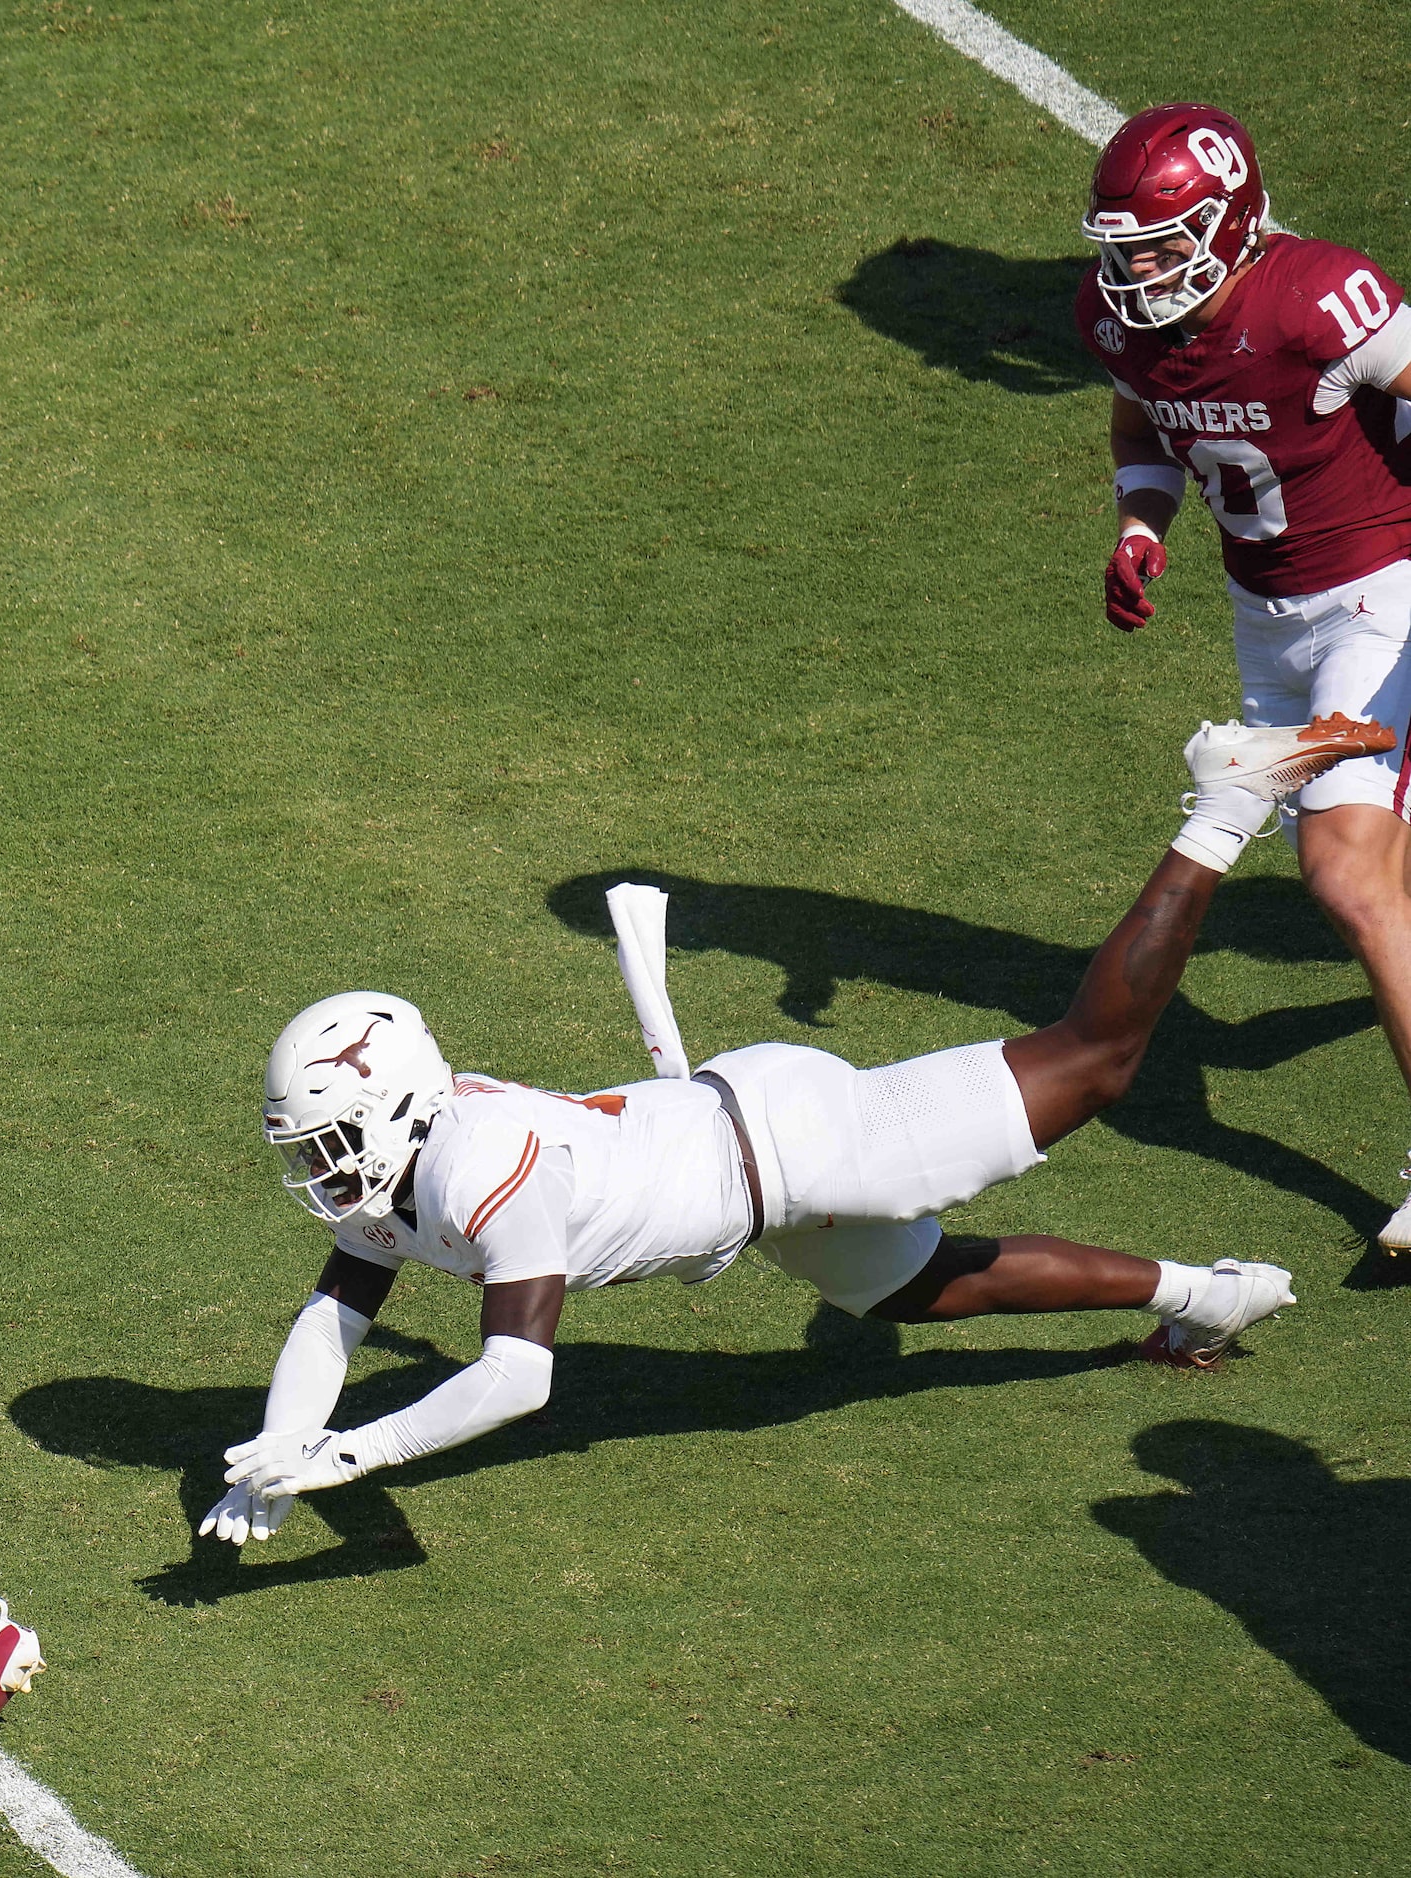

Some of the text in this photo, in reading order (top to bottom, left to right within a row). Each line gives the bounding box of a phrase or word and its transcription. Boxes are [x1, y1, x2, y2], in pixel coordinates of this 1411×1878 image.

[1095, 319, 1124, 353] SEC
[1317, 269, 1390, 349] 10
[1140, 398, 1271, 433] OONERS
[1158, 429, 1288, 541] 0
